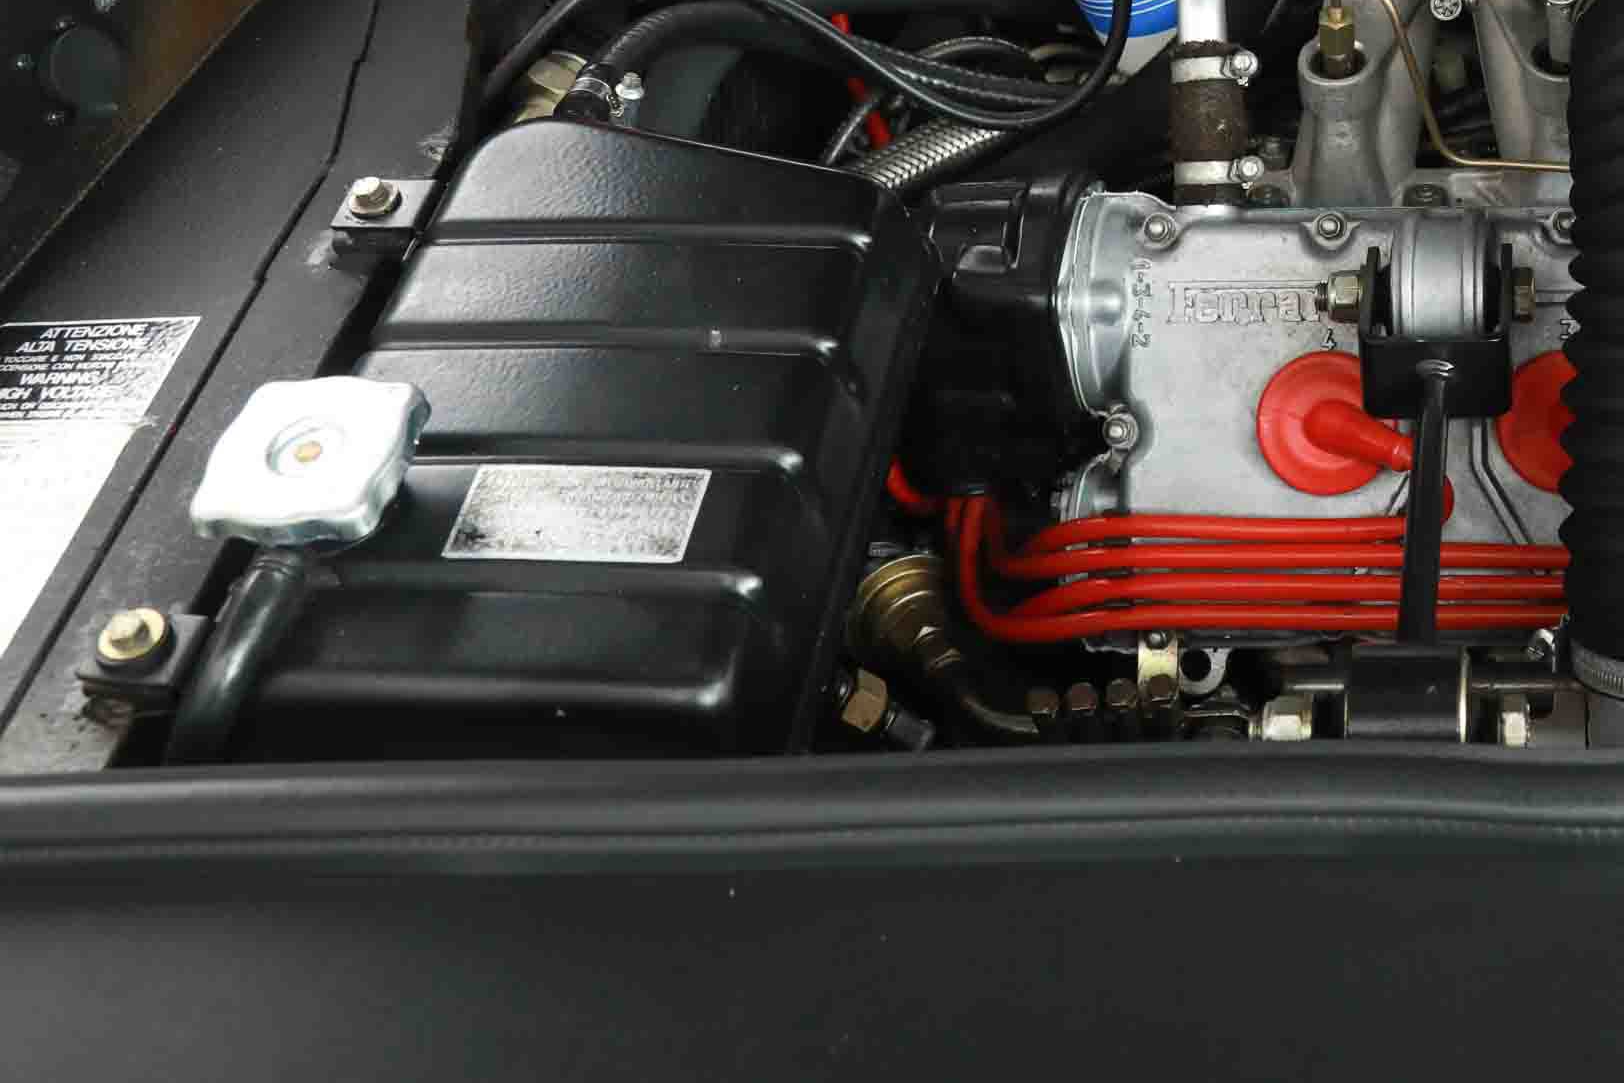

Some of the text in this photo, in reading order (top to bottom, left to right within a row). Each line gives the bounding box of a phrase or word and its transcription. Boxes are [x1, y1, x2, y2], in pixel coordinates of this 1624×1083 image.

[1167, 281, 1322, 322] Ferrar
[40, 324, 147, 339] ATTENZIONE
[16, 340, 56, 353] ALTA
[20, 371, 102, 386] WARNING
[0, 387, 33, 399] IGH
